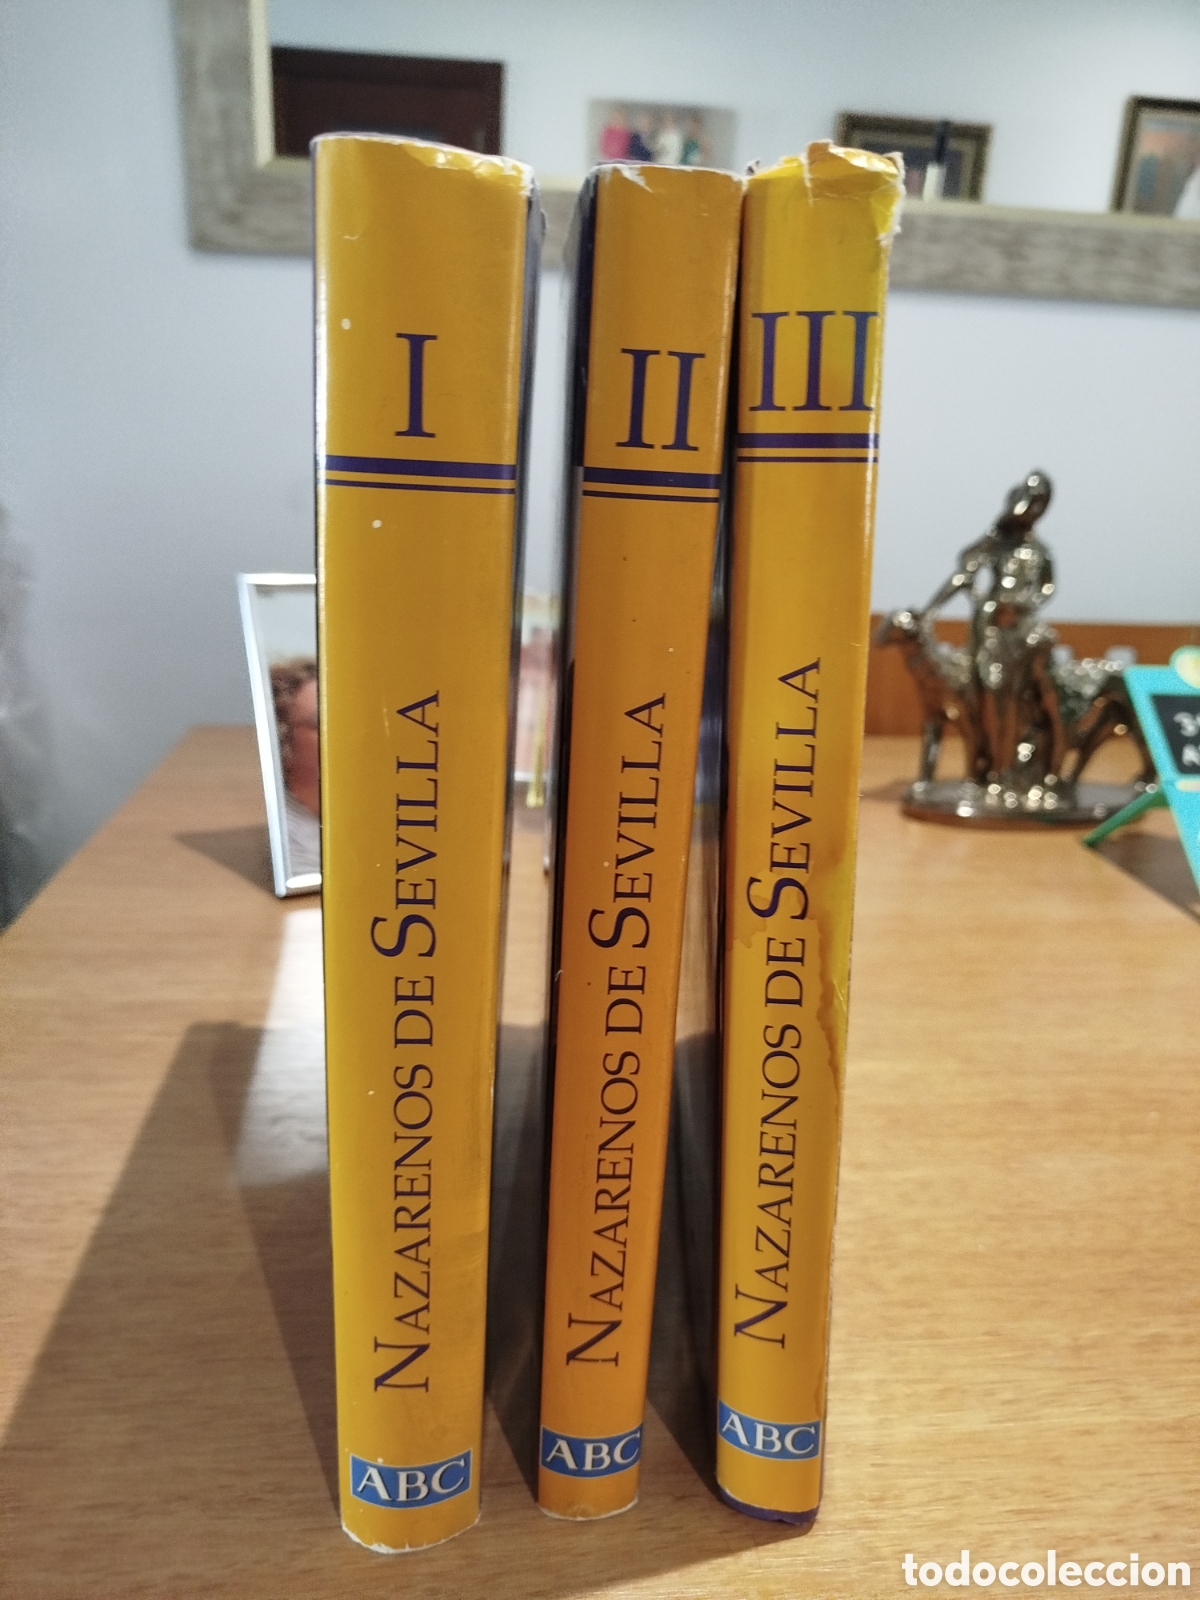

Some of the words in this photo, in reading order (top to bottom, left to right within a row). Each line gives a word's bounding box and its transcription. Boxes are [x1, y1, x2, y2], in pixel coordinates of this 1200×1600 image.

[395, 333, 437, 438] I
[615, 348, 705, 451] II
[749, 310, 878, 411] III
[371, 690, 439, 958] SEVILLA
[588, 693, 666, 949] SEVILLA
[746, 657, 820, 920] SEVILLA
[393, 975, 434, 1047] DE
[605, 965, 646, 1035] DE
[764, 937, 805, 1008] DE
[373, 1064, 433, 1392] NAZARENOS
[566, 1051, 641, 1366] NAZARENOS
[733, 1023, 801, 1349] NAZARENOS
[356, 1458, 466, 1501] ABC
[545, 1429, 641, 1471] ABC
[720, 1411, 817, 1454] ABC
